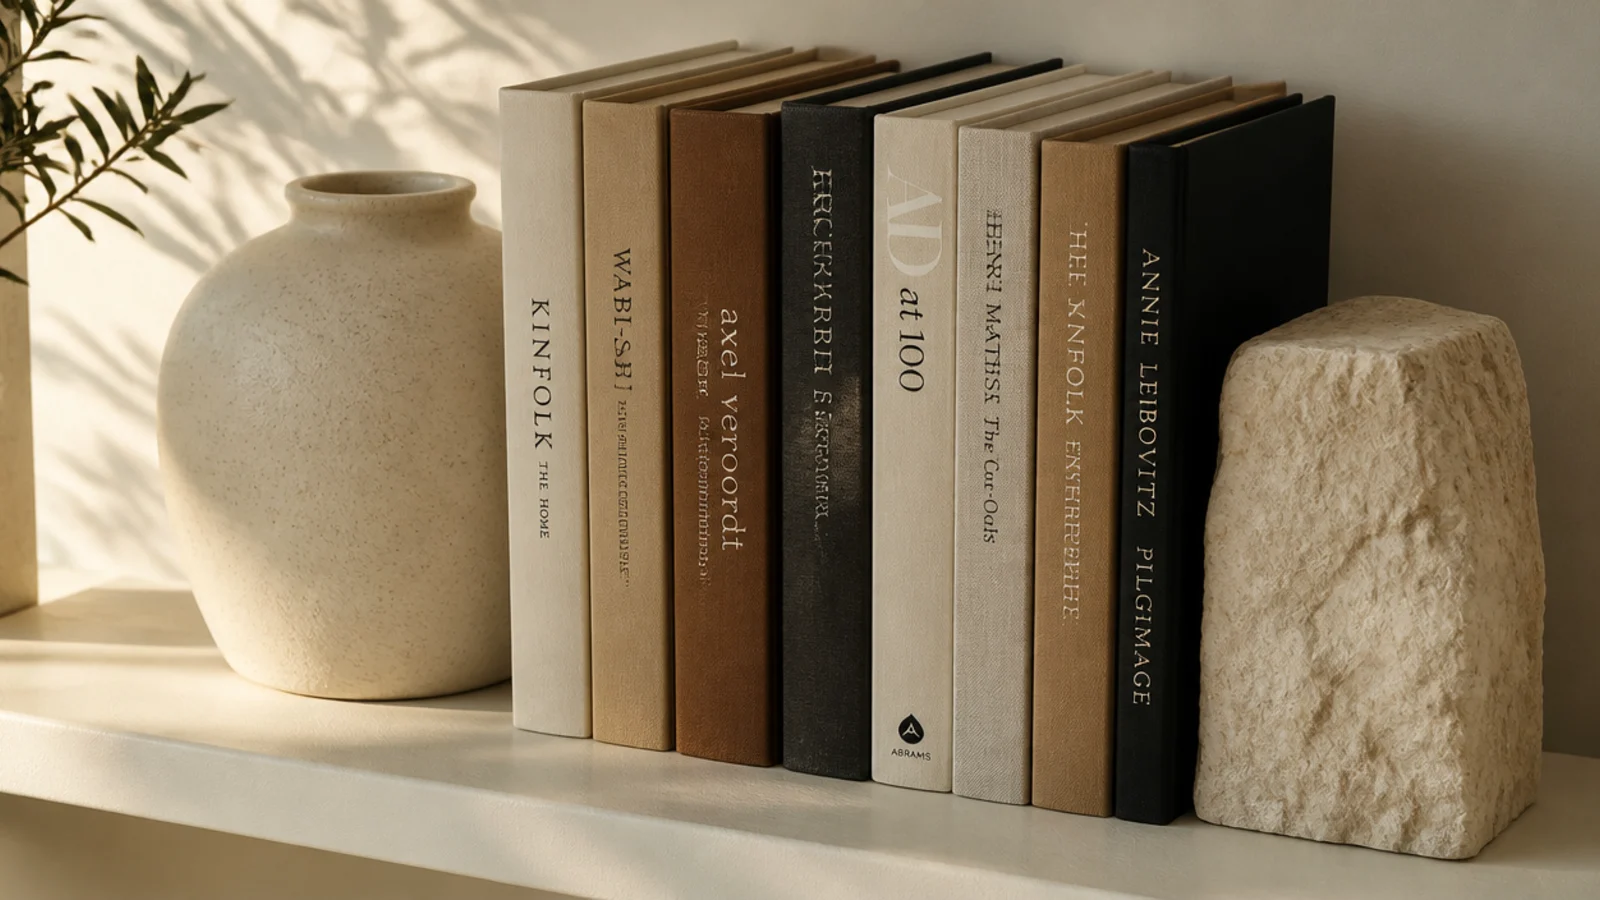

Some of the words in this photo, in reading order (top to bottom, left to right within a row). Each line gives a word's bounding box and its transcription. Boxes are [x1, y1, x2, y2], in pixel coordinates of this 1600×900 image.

[886, 166, 942, 277] AD
[899, 288, 924, 321] at
[1140, 248, 1161, 346] ANNIE
[531, 298, 553, 450] KINFOLK
[720, 308, 747, 378] axel
[899, 331, 924, 393] 100
[983, 416, 1000, 453] The
[1136, 362, 1158, 517] LEIBOVITZ
[538, 461, 549, 490] THE
[721, 394, 747, 551] veroordt
[539, 498, 550, 539] HOME
[1132, 546, 1154, 706] PILGIMAGE
[891, 748, 932, 761] ABRAMS
